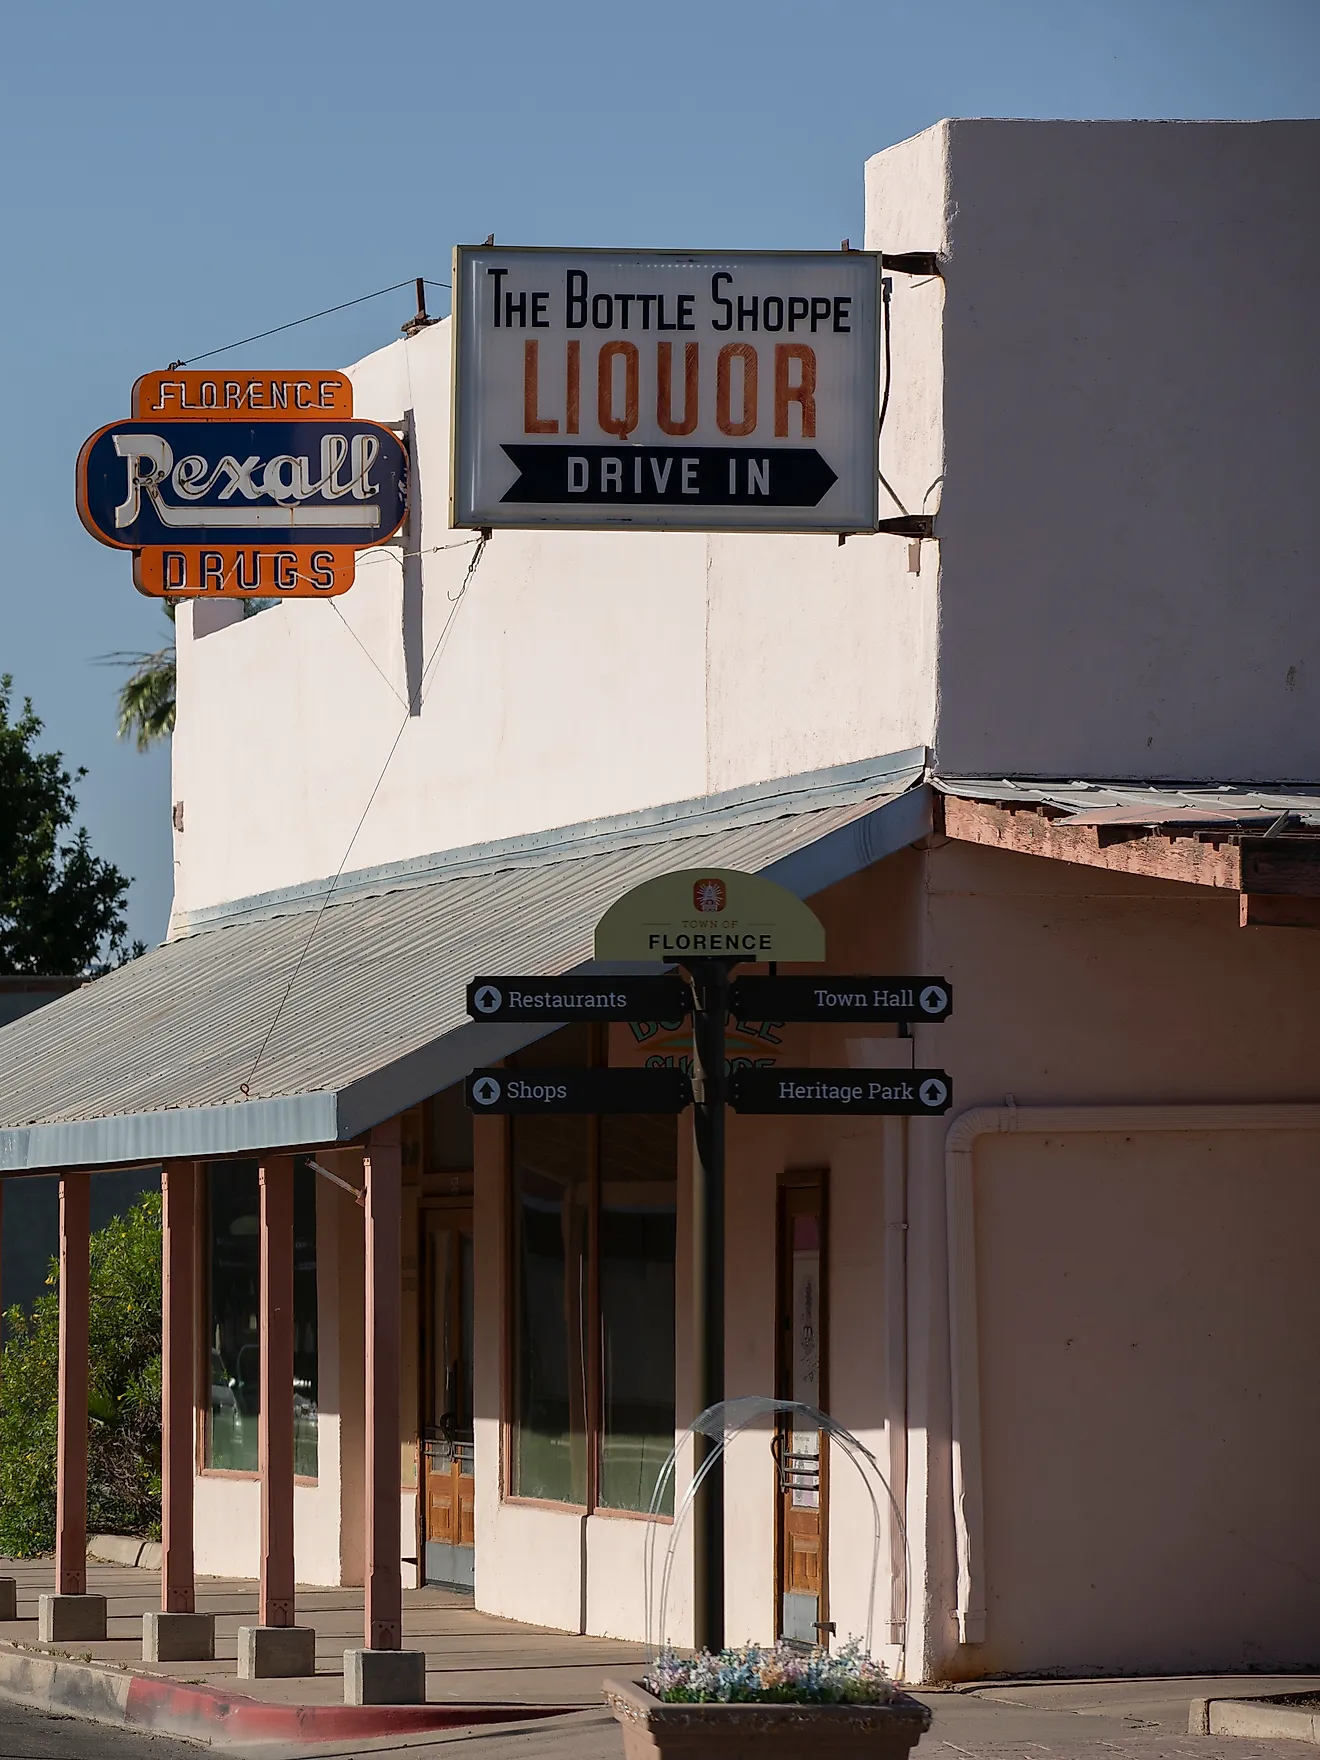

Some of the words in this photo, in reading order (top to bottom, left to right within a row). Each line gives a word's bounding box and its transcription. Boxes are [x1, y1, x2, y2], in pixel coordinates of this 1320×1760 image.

[487, 268, 550, 329] THE
[565, 269, 696, 331] BOTTLE
[711, 271, 852, 333] SHOPPE
[151, 380, 342, 411] FLORENCE
[523, 338, 817, 441] LIQUOR
[112, 434, 381, 529] Rexall
[567, 456, 700, 495] DRIVE
[729, 457, 770, 496] IN
[162, 550, 335, 591] DRUGS
[681, 919, 719, 930] TOWN
[721, 919, 739, 930] OF
[648, 934, 773, 951] FLORENCE
[508, 990, 627, 1010] Restaurants
[814, 990, 868, 1008] Town
[873, 989, 914, 1008] Hall
[506, 1081, 568, 1101] Shops
[779, 1081, 863, 1103] Heritage
[868, 1081, 914, 1100] Park
